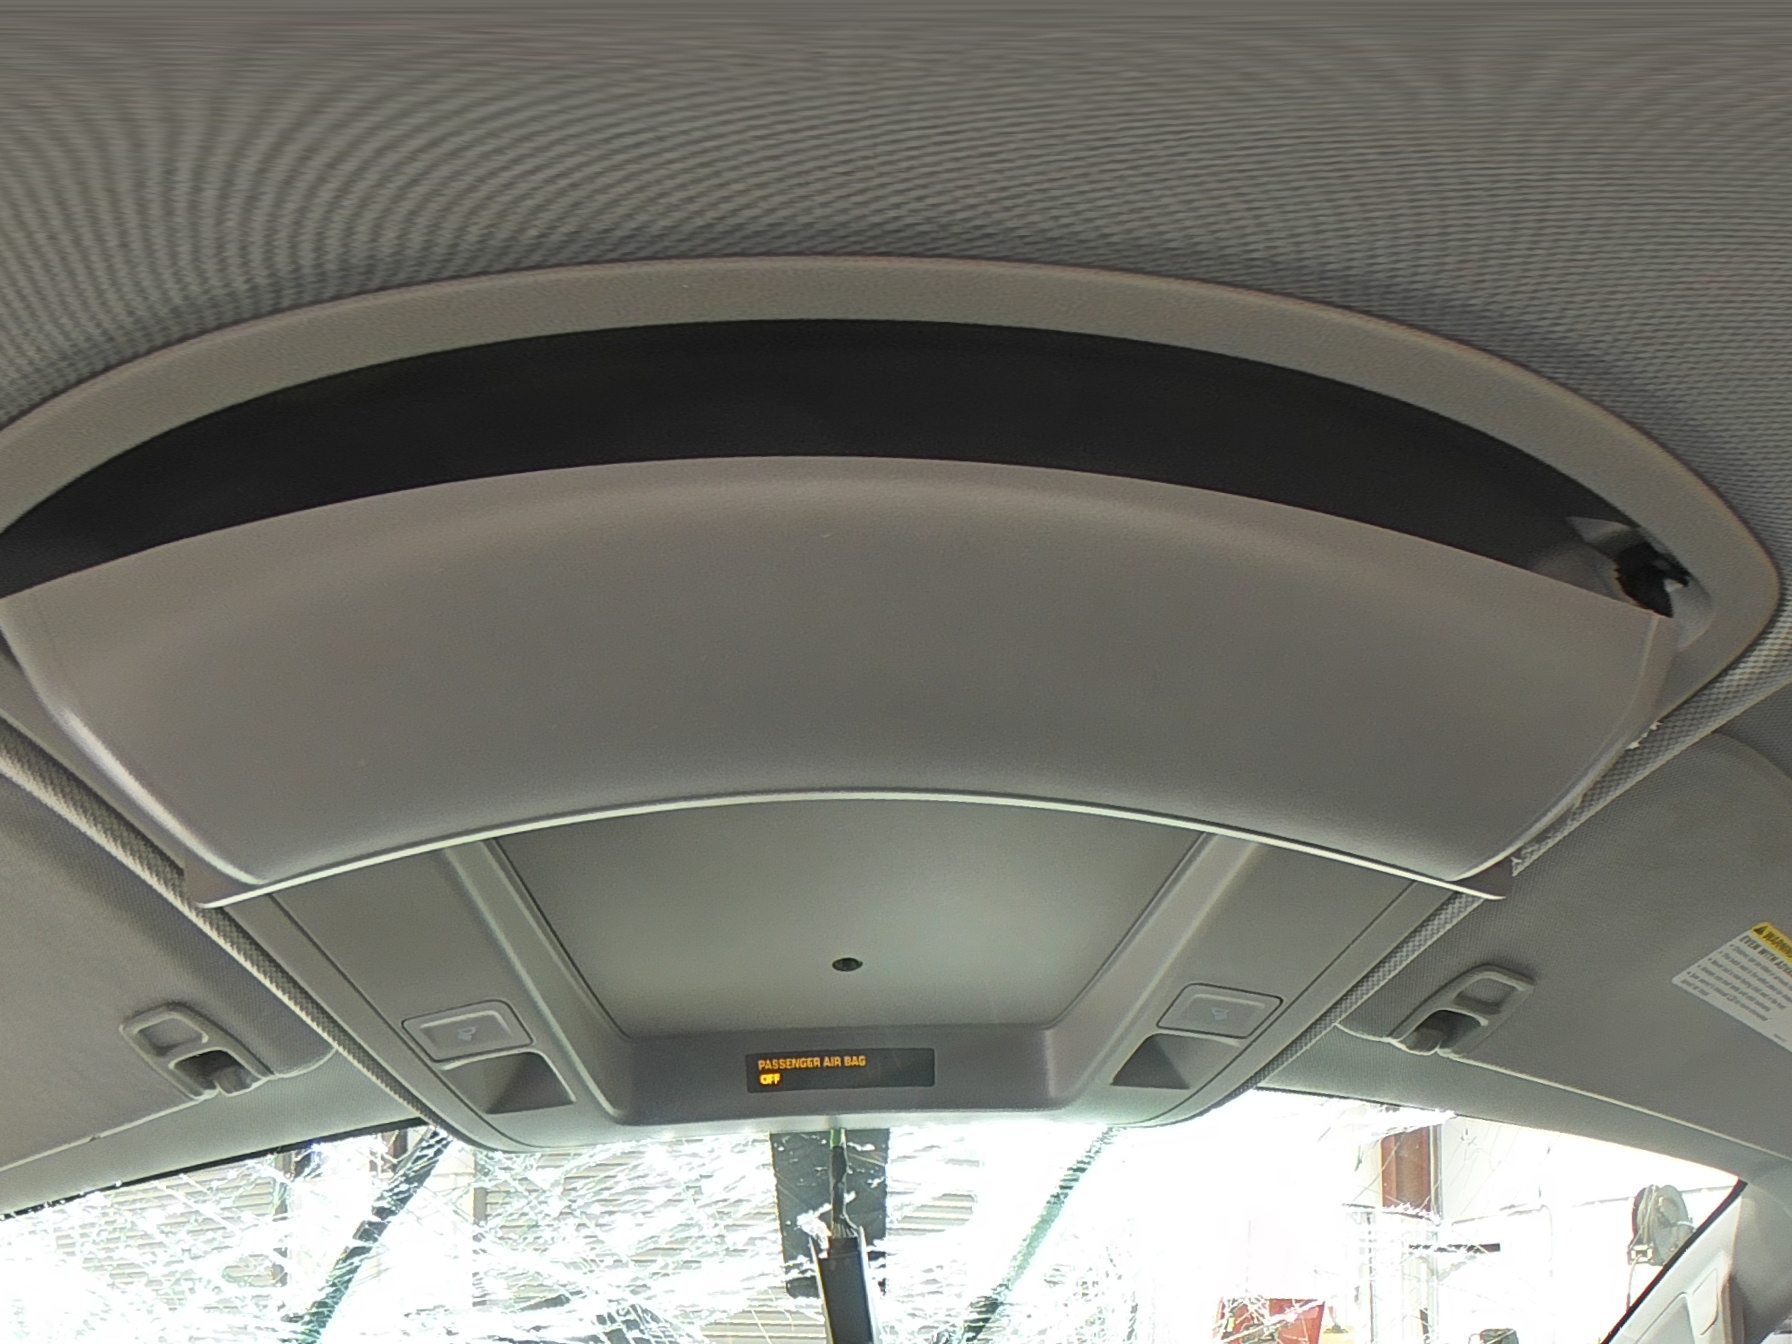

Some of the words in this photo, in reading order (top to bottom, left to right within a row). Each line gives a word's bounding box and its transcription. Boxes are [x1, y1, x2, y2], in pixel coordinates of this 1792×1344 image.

[758, 1057, 821, 1070] PASSENGER
[823, 1056, 841, 1068] AIR
[843, 1055, 867, 1067] BAG
[760, 1073, 781, 1085] OFF
